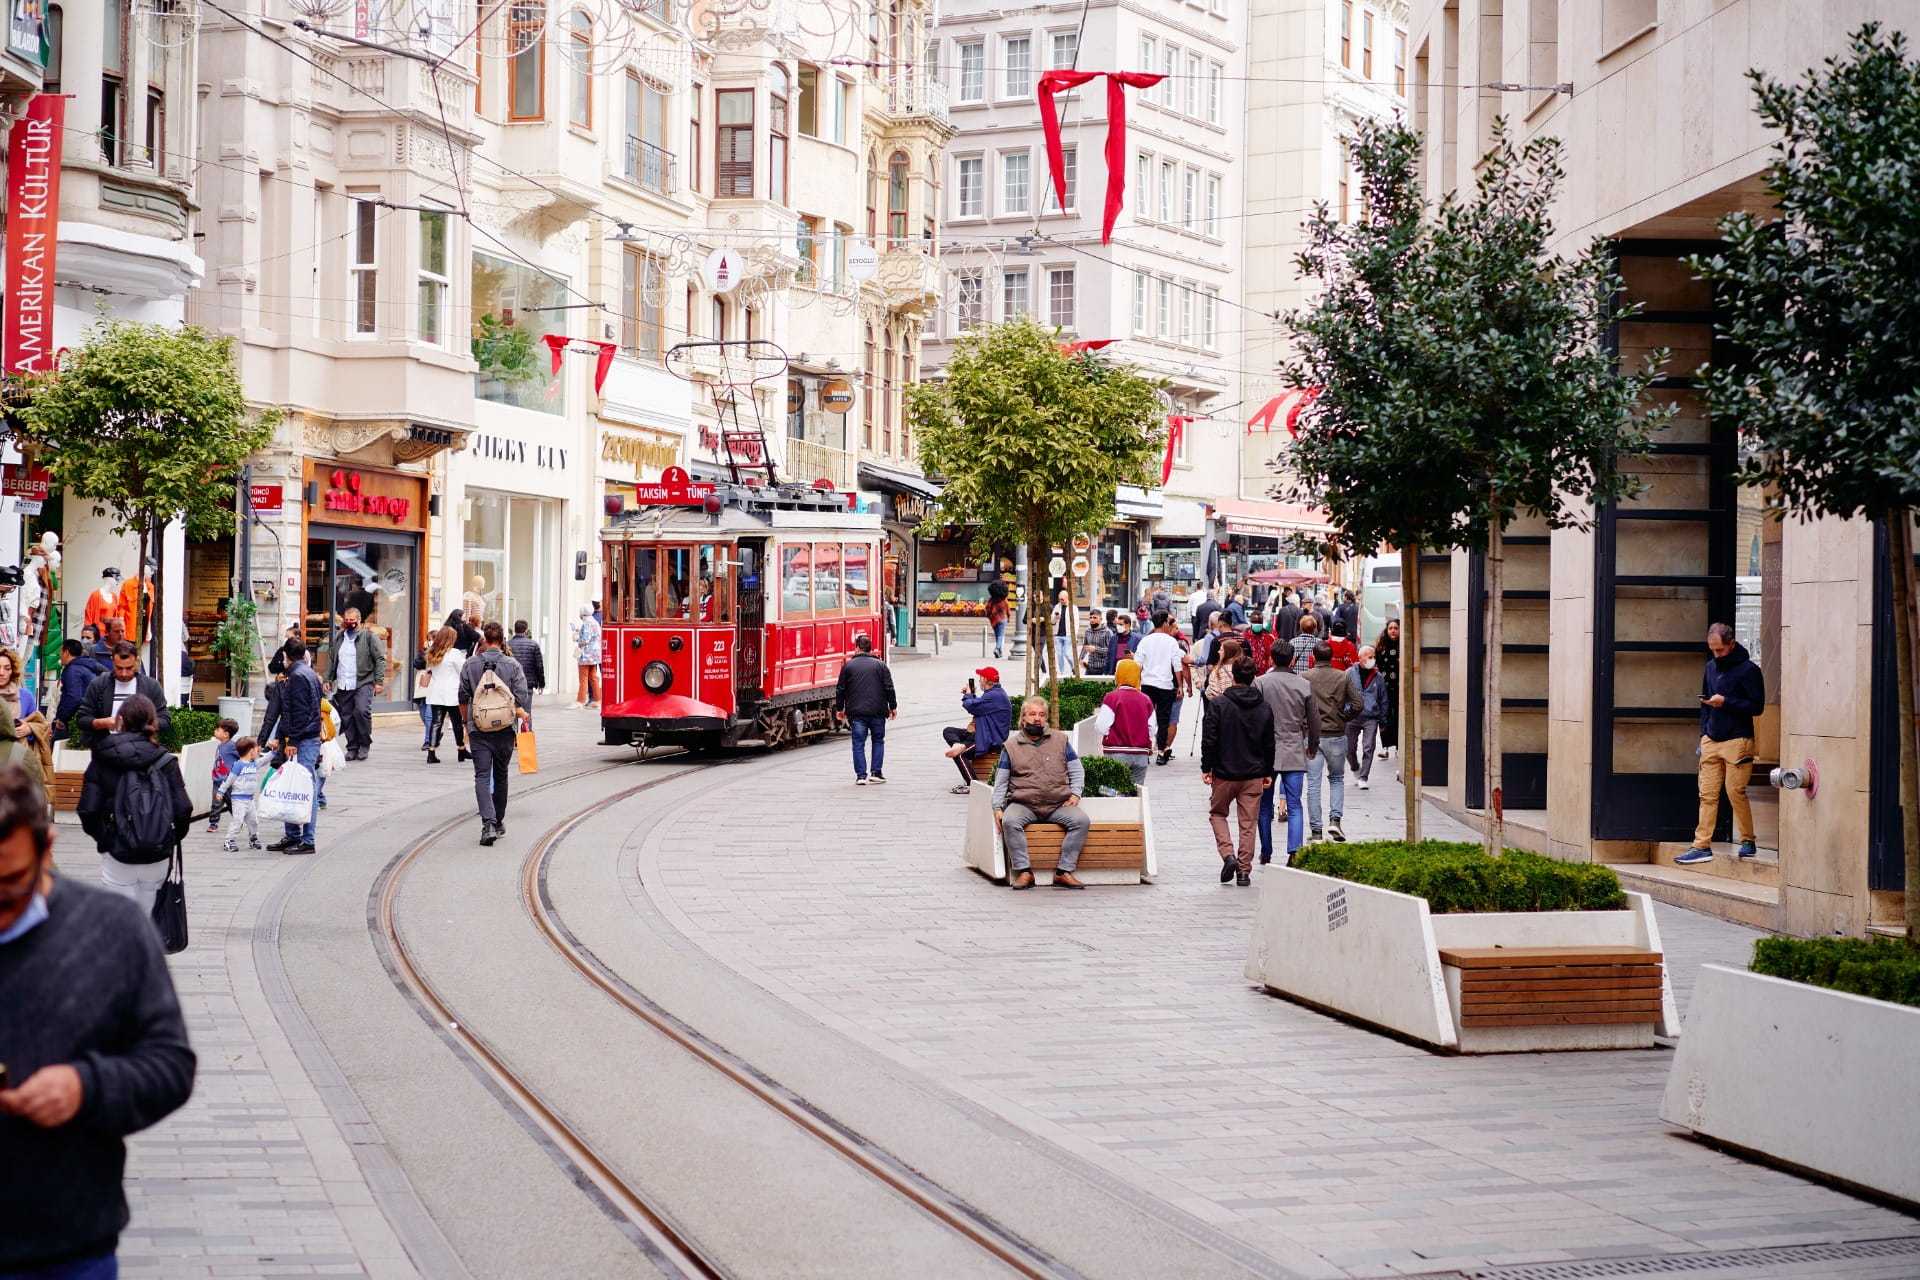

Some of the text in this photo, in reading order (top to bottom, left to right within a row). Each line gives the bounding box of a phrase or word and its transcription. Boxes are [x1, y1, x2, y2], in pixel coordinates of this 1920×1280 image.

[14, 117, 52, 374] AMERİKAN KÜLTÜR
[671, 468, 679, 482] 2
[2, 478, 47, 492] BERBER
[251, 487, 270, 496] TÜNCÜ
[638, 485, 669, 500] TAKSİM
[713, 640, 725, 652] 223
[278, 790, 311, 801] WAIKIK
